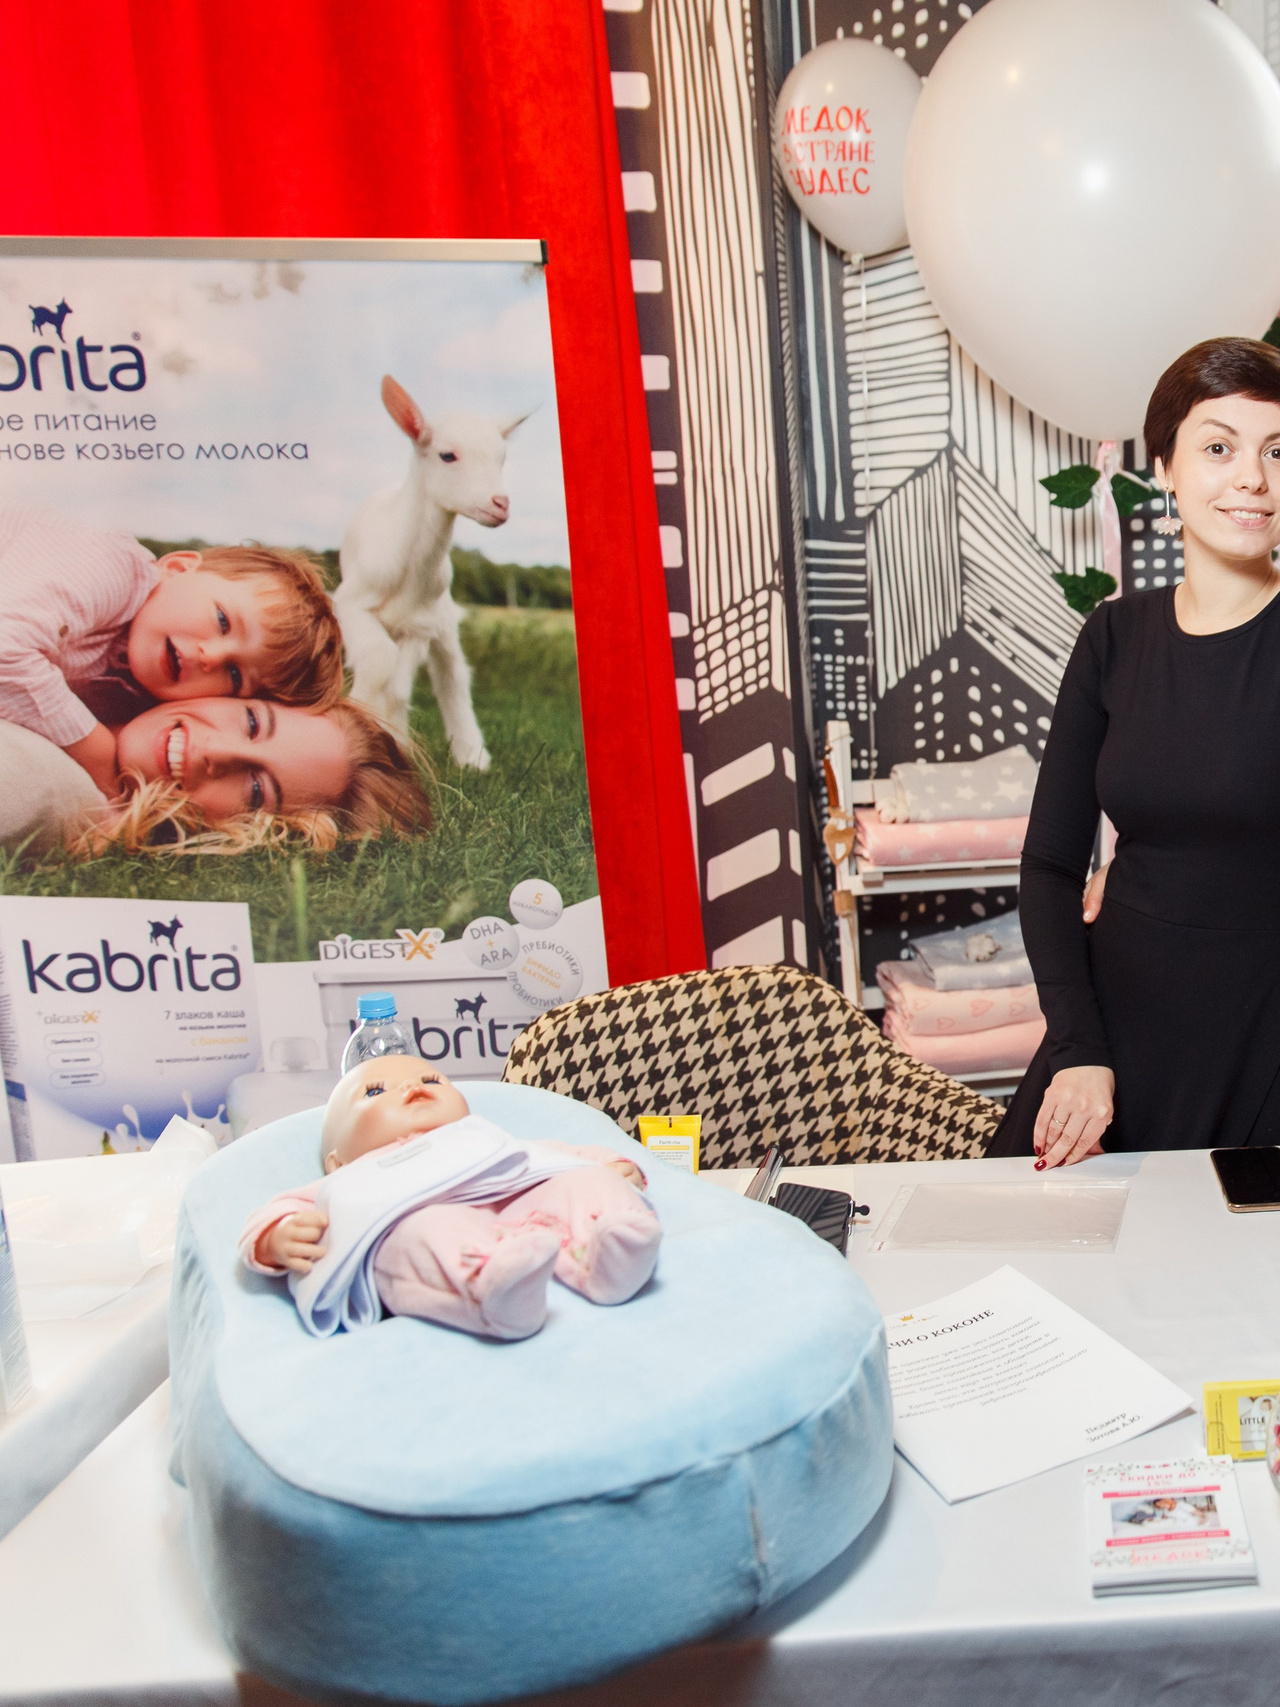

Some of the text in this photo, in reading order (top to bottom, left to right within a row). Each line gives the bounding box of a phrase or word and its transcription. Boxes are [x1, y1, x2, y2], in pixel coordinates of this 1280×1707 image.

[781, 105, 872, 135] МЕДОК
[794, 140, 875, 163] СТРАНЕ
[0, 413, 156, 431] е питание
[76, 440, 185, 461] козьего
[195, 439, 309, 461] молока
[533, 892, 543, 906] 5
[470, 922, 504, 940] DHA
[22, 939, 241, 994] kabrita
[480, 948, 513, 966] ARA
[522, 941, 580, 976] ПРЕБИОТИКИ
[164, 1010, 245, 1020] 7 злаков каша
[916, 1334, 929, 1342] О
[931, 1308, 995, 1338] КОКОНЕ
[1085, 1412, 1127, 1434] Педиатр
